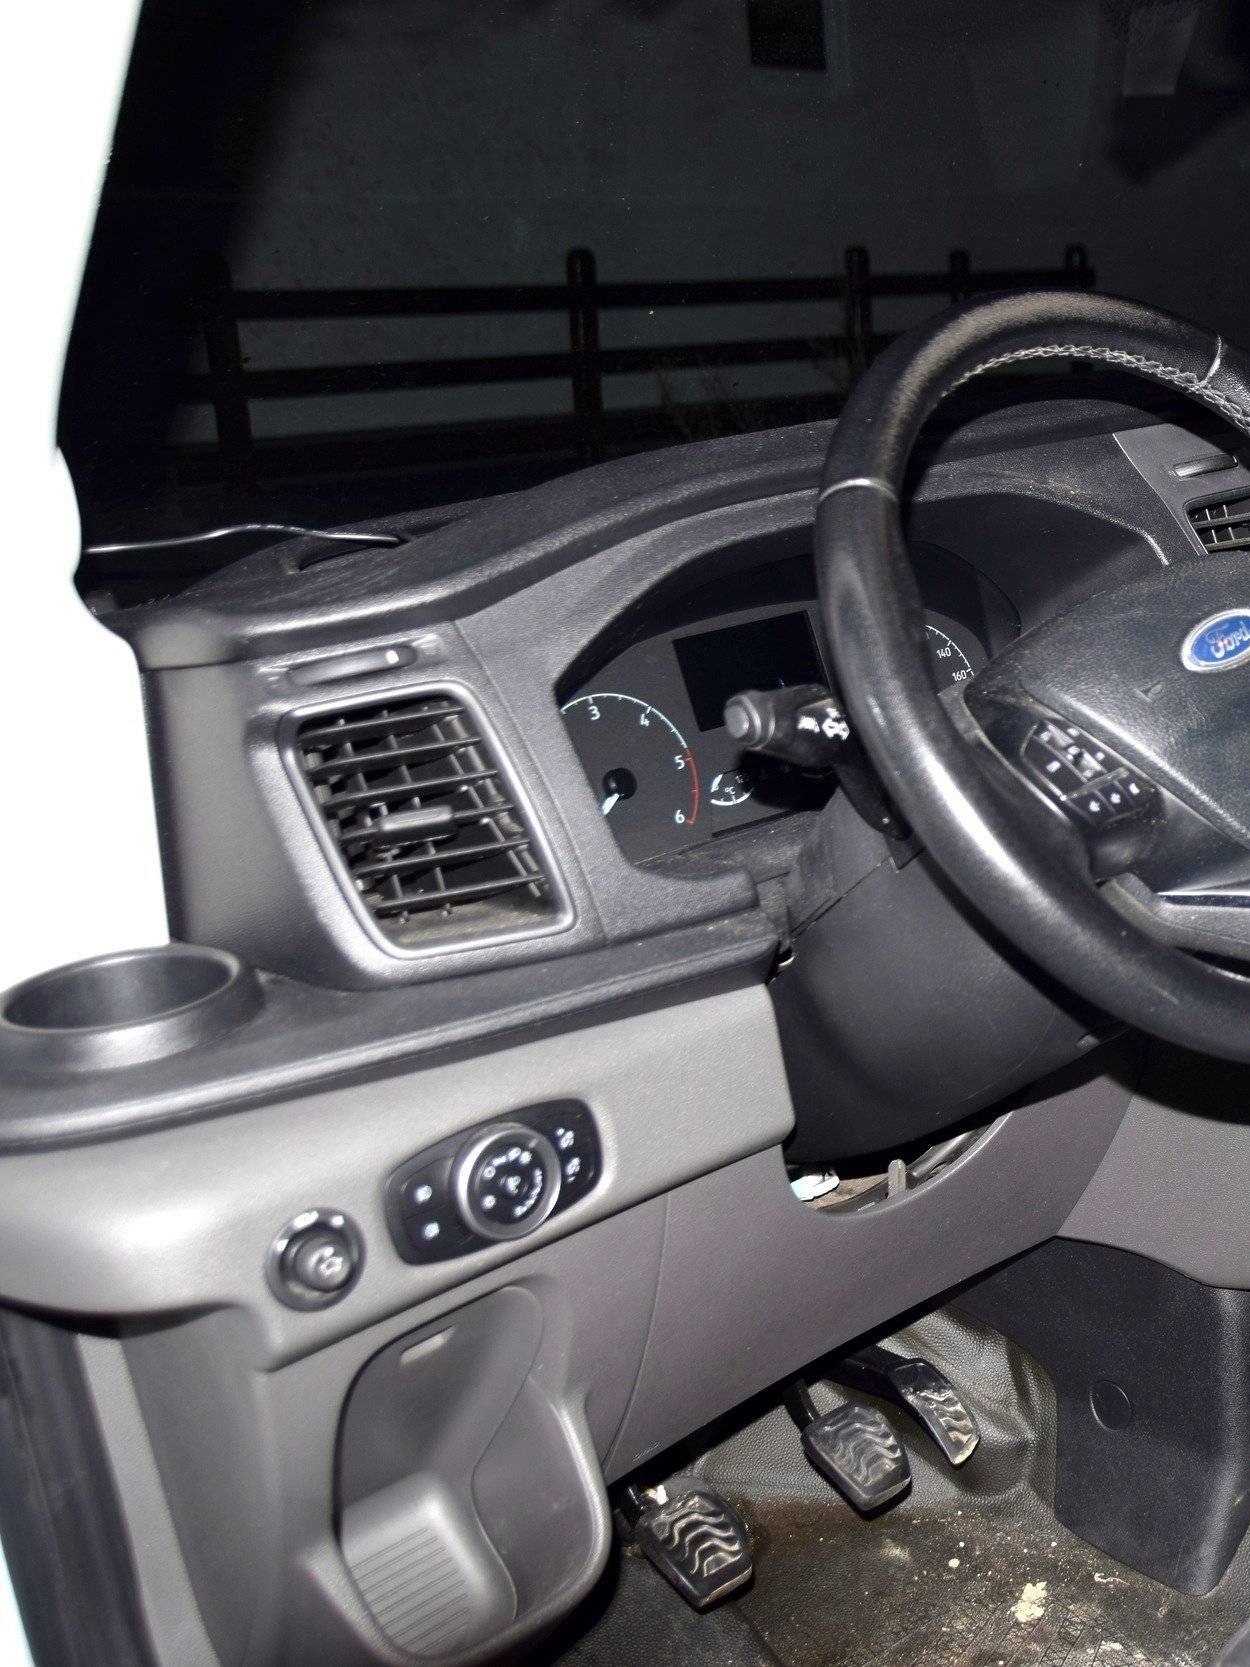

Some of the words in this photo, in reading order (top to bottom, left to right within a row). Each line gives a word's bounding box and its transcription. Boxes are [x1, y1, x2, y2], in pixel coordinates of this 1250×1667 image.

[936, 646, 952, 659] 140
[951, 669, 967, 682] 160
[588, 705, 601, 721] 3
[639, 713, 650, 727] 4
[674, 755, 685, 770] 5
[674, 809, 686, 824] 6
